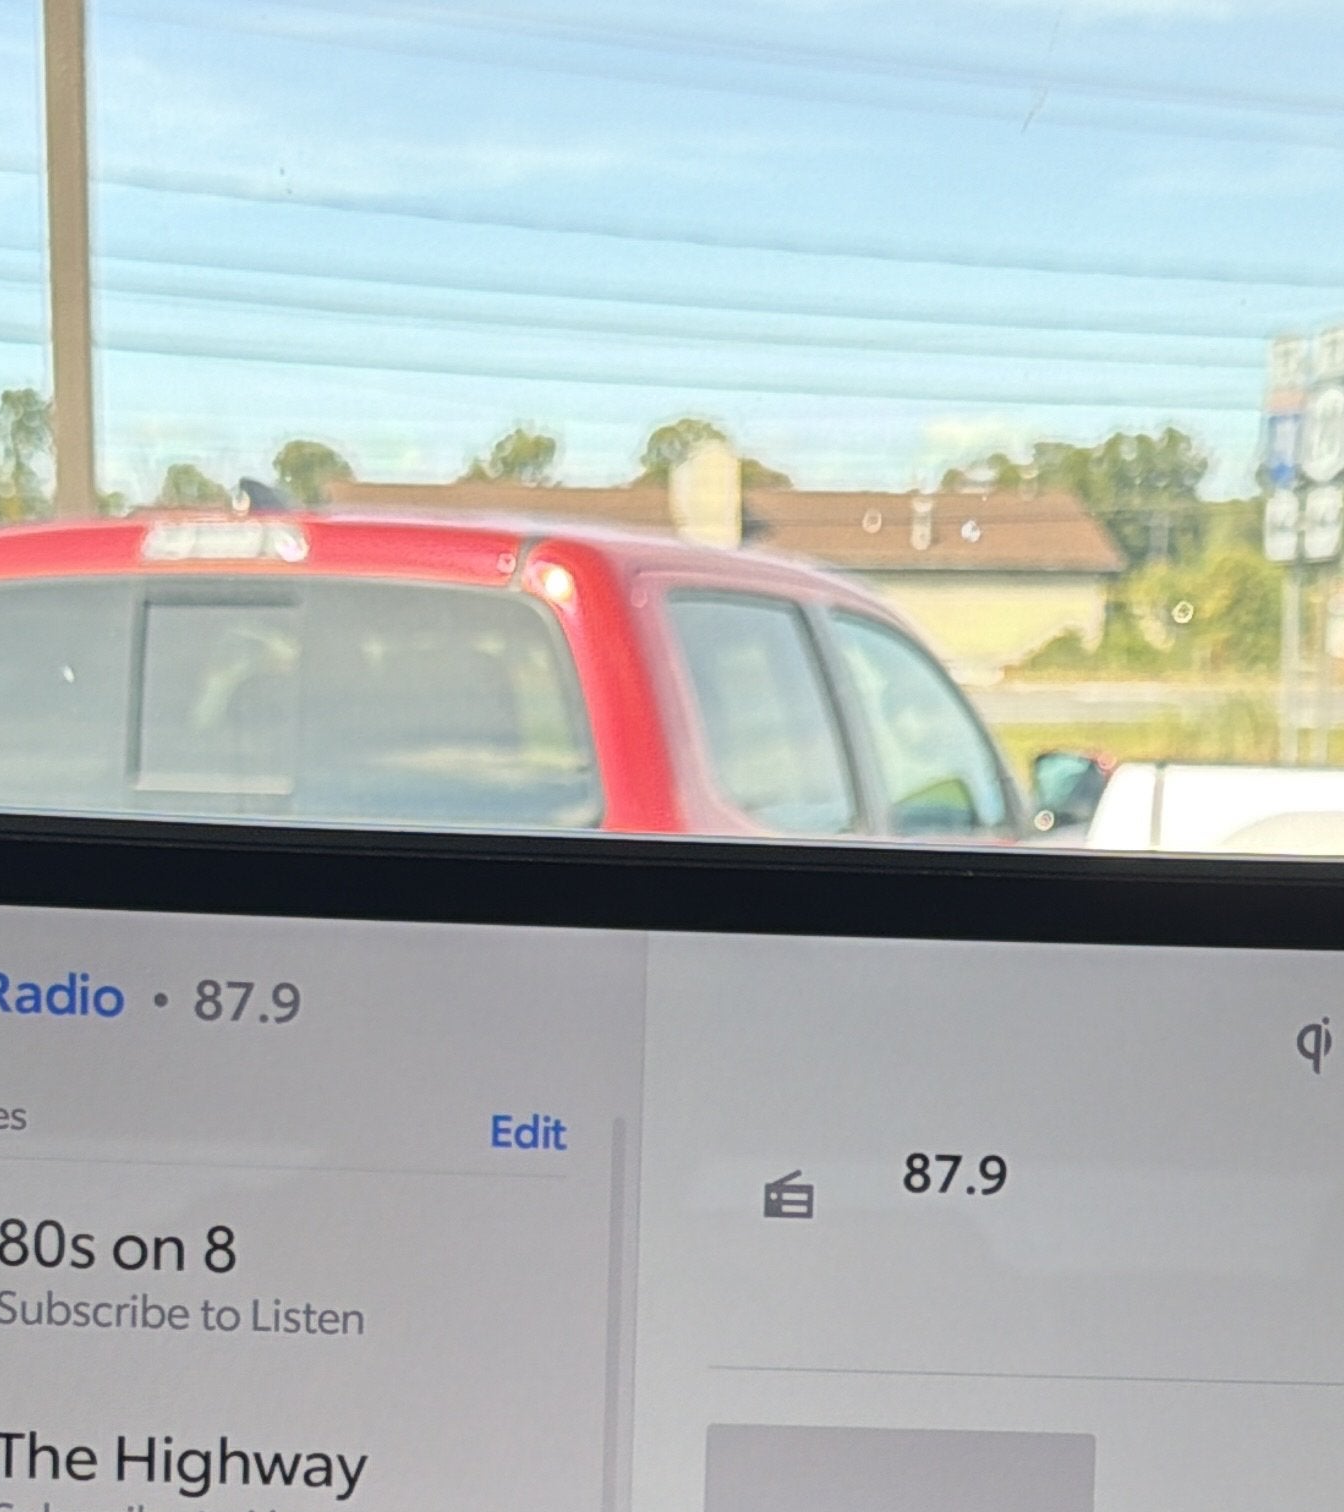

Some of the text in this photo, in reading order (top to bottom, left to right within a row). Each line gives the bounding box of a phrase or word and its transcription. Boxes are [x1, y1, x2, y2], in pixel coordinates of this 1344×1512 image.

[193, 979, 301, 1025] 87.9
[491, 1113, 567, 1151] Edit
[903, 1152, 1007, 1196] 87.9
[112, 1234, 185, 1272] on
[204, 1225, 236, 1274] 8
[200, 1299, 241, 1332] to
[252, 1298, 364, 1336] Listen
[117, 1435, 368, 1501] Highway
